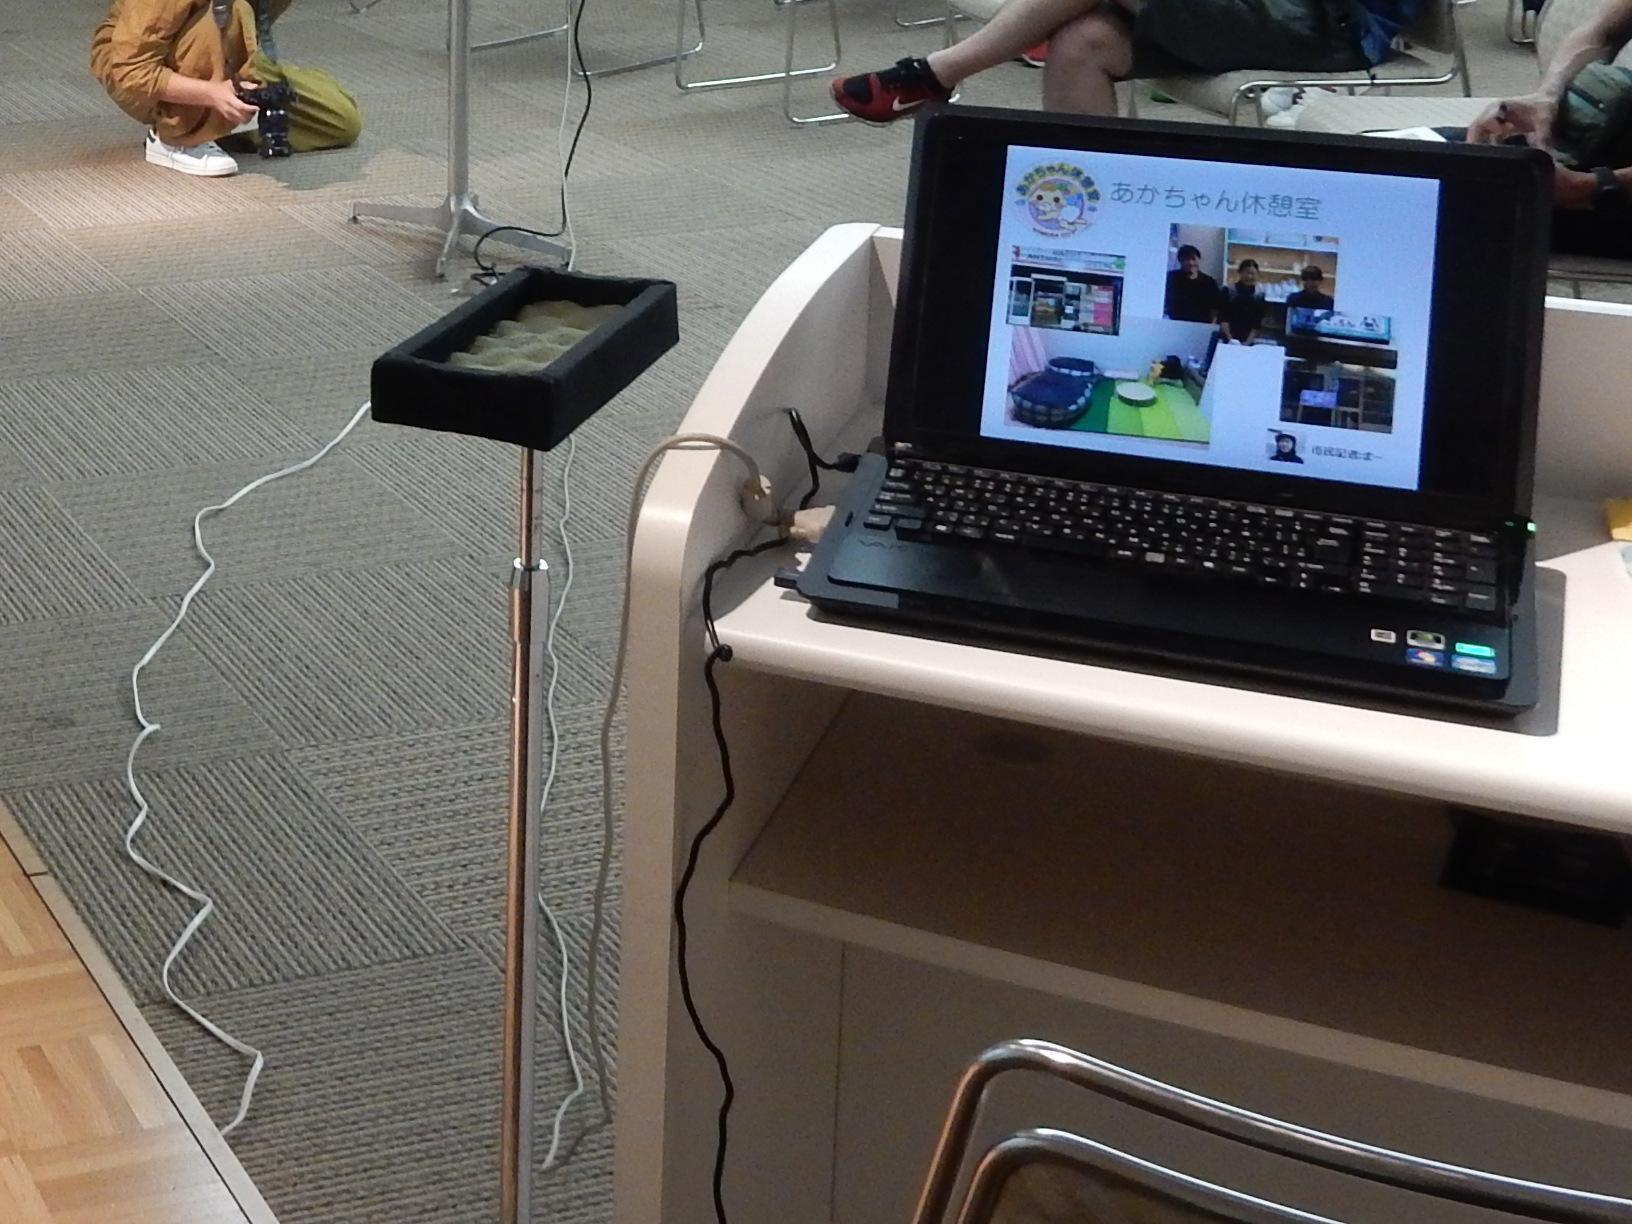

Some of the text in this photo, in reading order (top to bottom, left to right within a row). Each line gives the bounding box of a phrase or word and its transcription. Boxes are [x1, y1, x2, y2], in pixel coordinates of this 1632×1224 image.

[1110, 181, 1322, 220] あかちゃん休憩室
